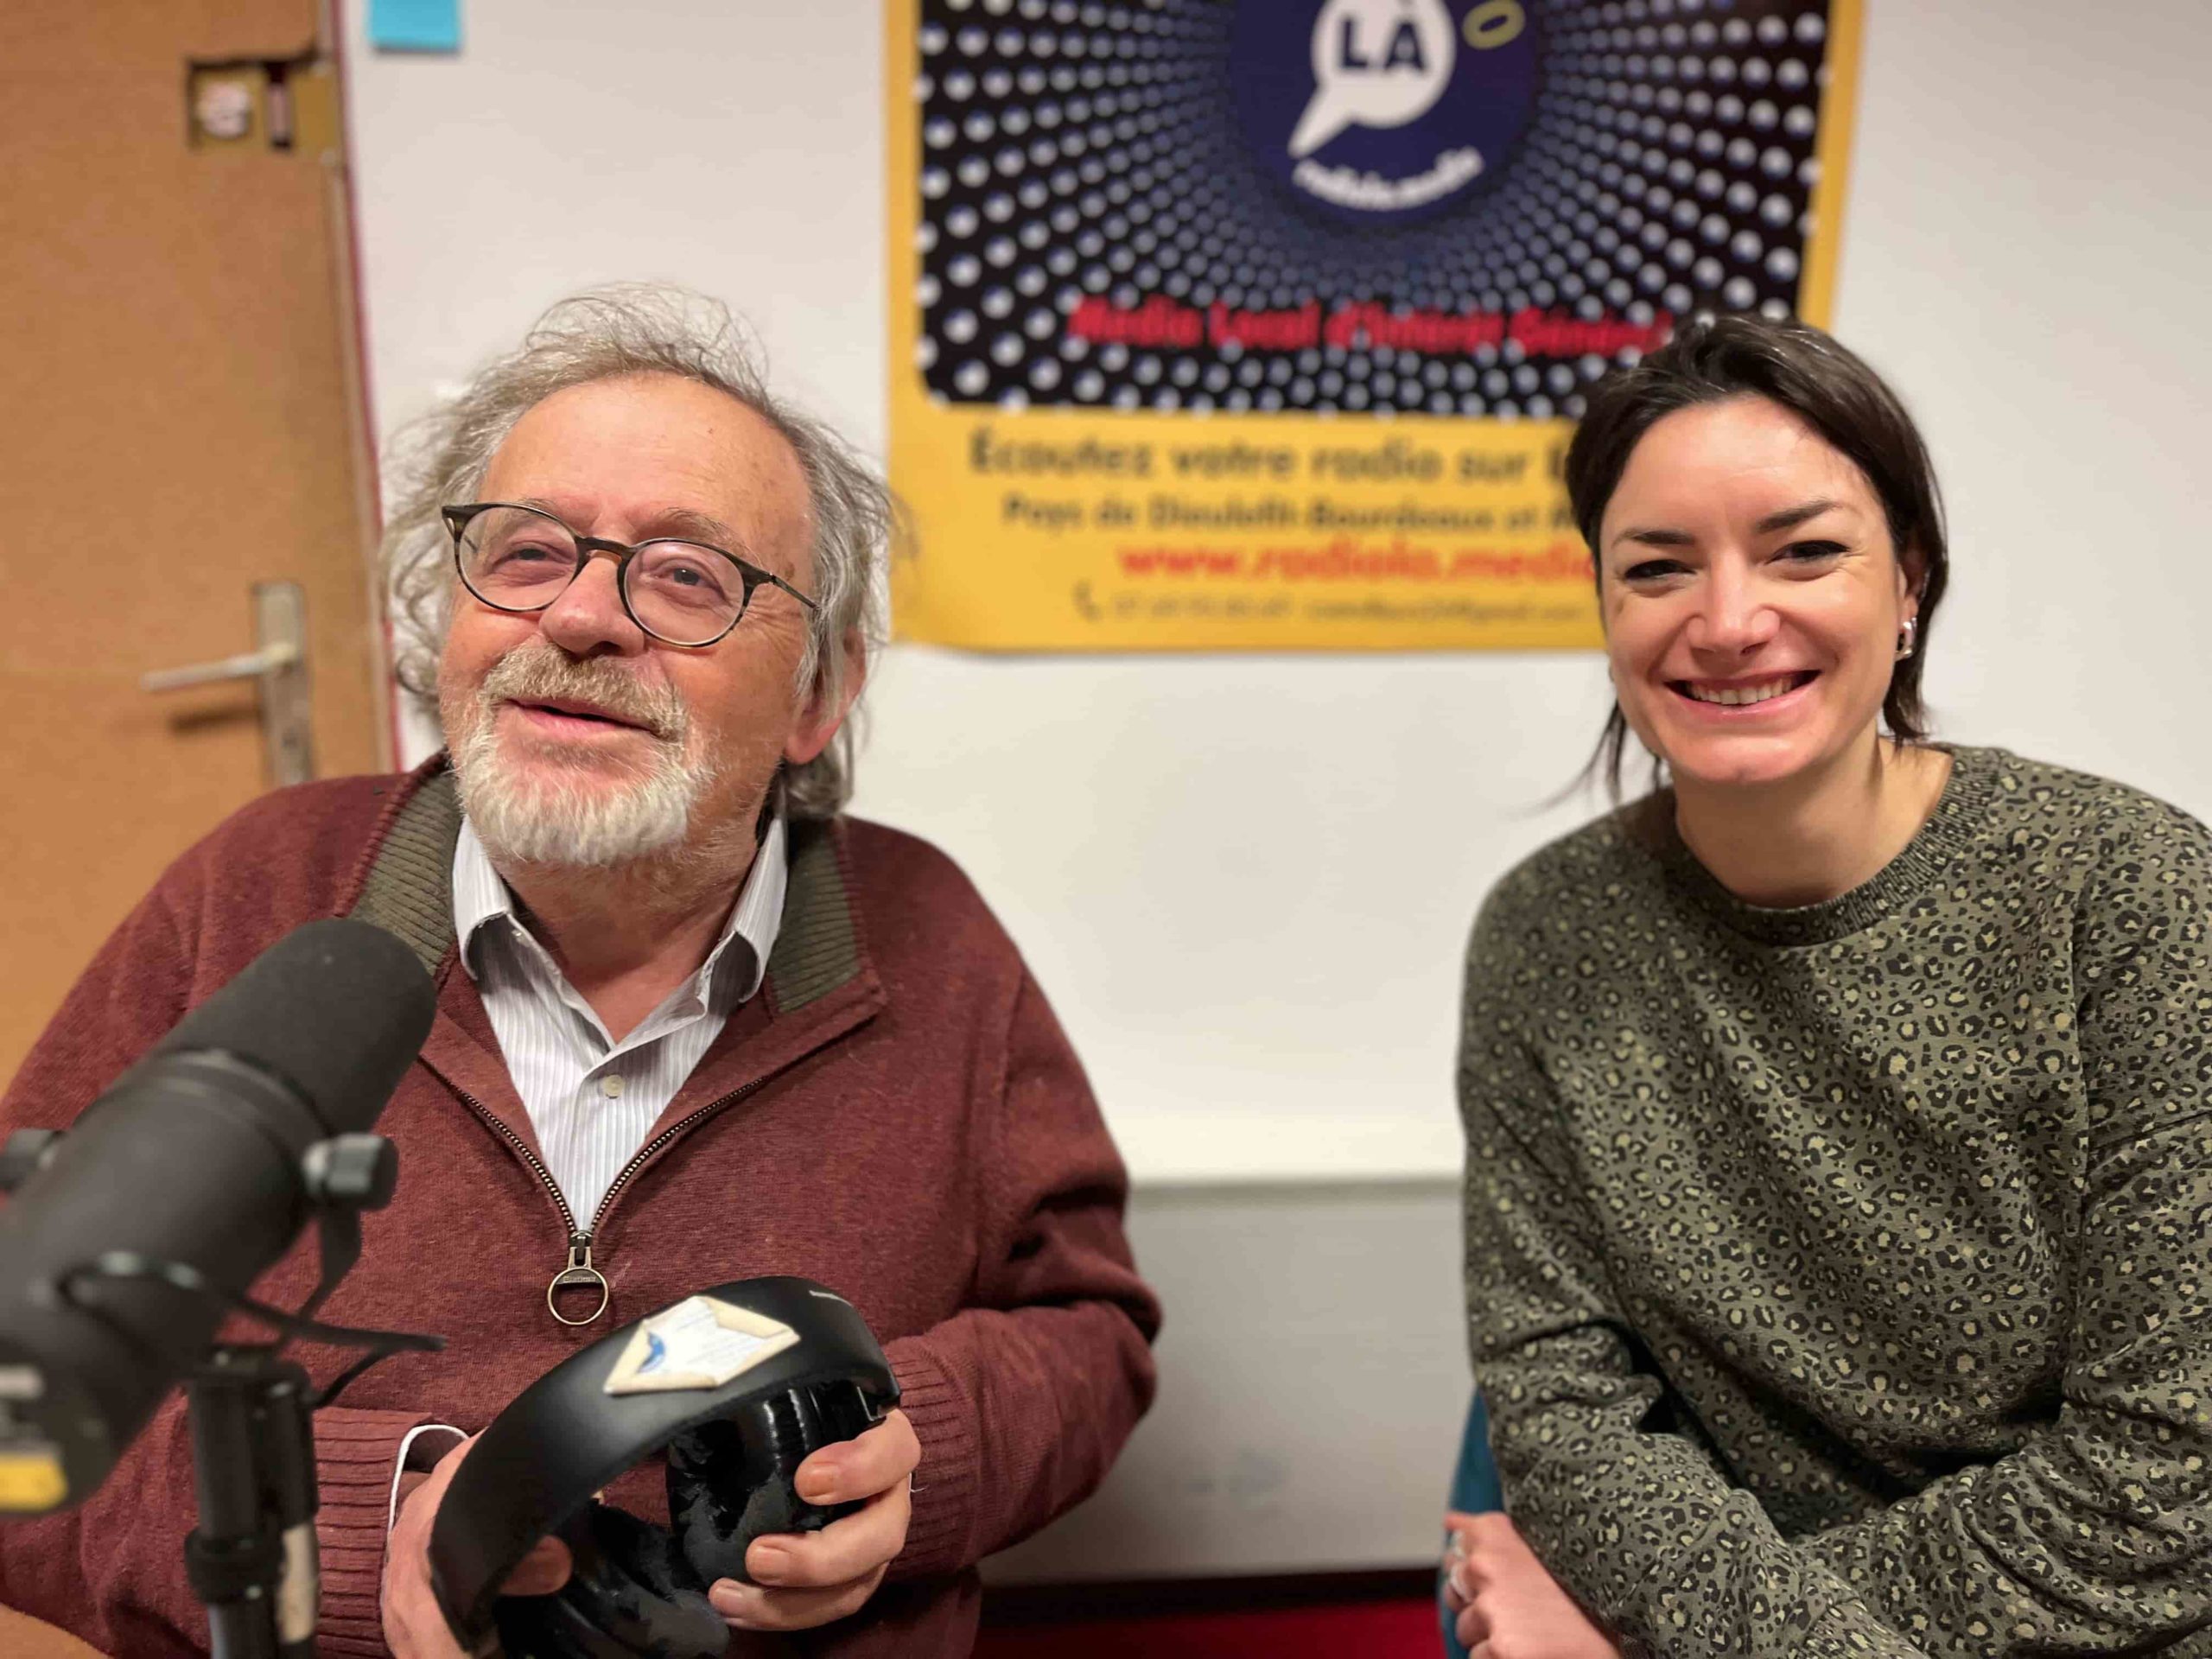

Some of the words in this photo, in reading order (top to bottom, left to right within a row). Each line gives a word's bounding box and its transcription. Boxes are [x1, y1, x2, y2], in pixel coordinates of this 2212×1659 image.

[1173, 438, 1293, 478] votre
[1312, 438, 1440, 480] radio
[1457, 451, 1534, 481] sur
[1003, 494, 1085, 531] Pays
[1096, 496, 1139, 527] de
[1504, 505, 1537, 532] et
